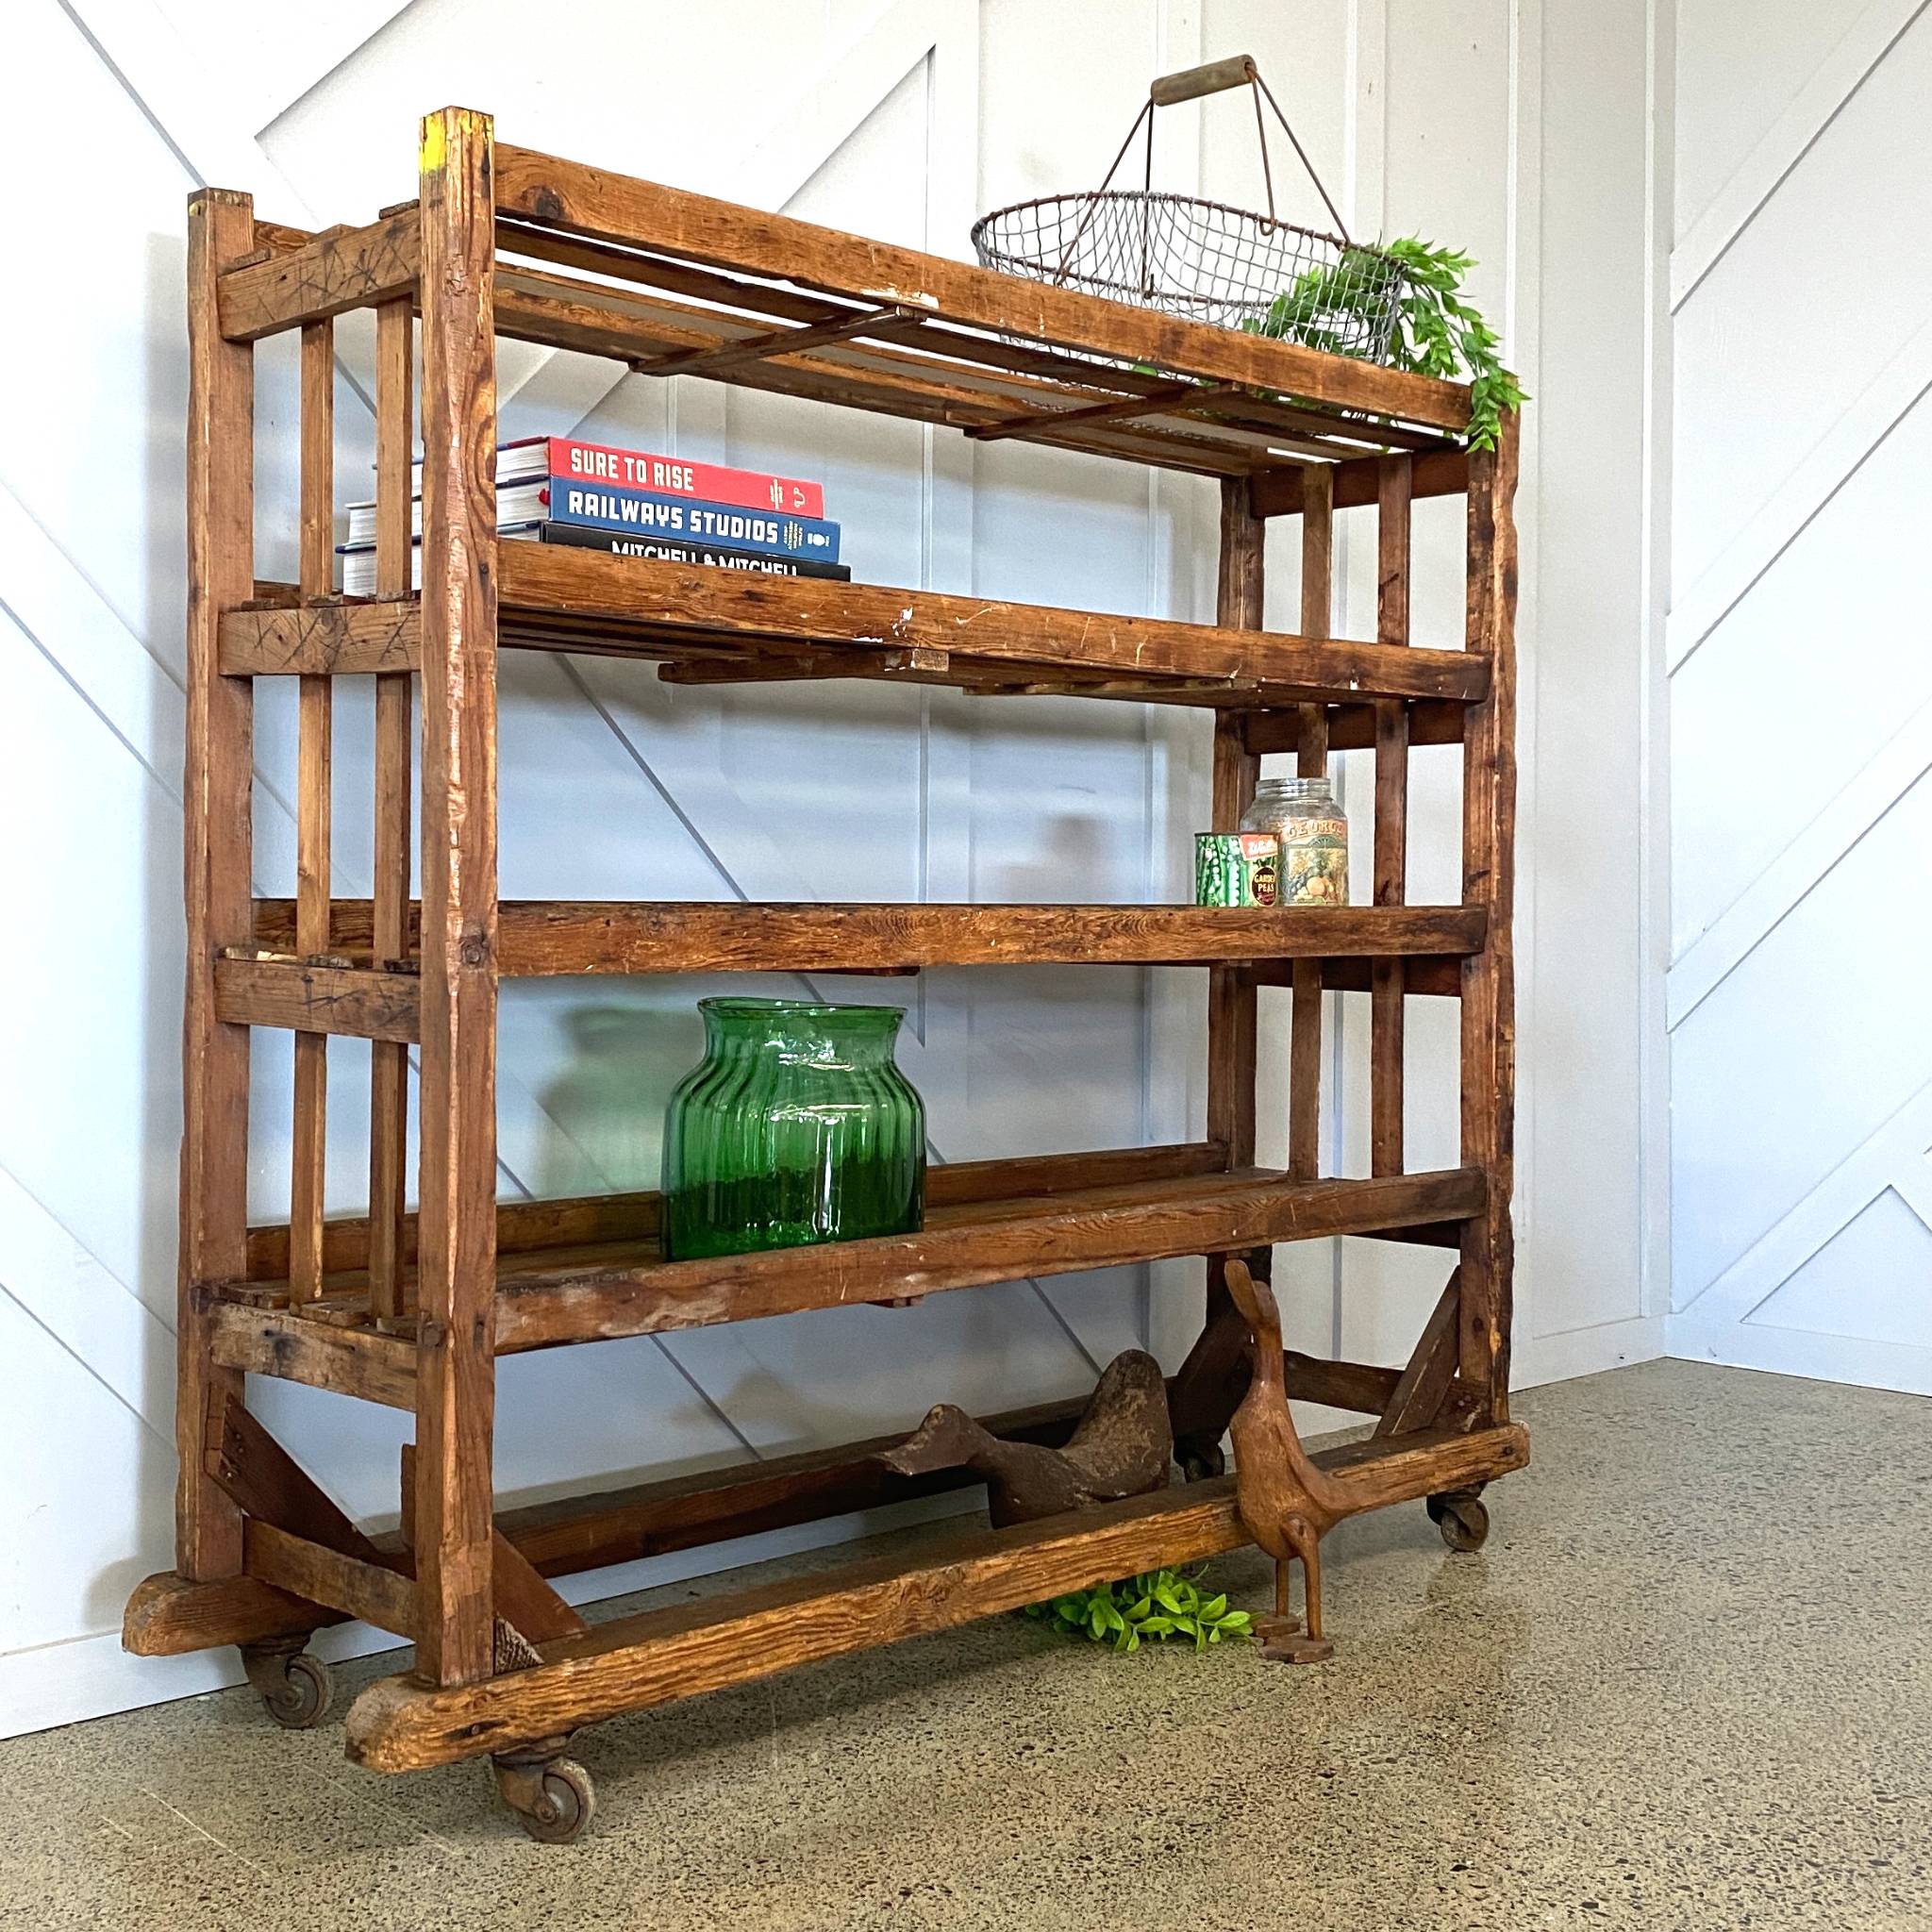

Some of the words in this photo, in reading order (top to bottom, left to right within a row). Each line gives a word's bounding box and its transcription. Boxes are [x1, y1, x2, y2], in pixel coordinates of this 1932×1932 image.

[571, 447, 620, 479] SURE
[624, 457, 648, 484] TO
[653, 461, 695, 491] RISE
[568, 490, 683, 530] RAILWAYS
[690, 509, 779, 544] STUDIOS
